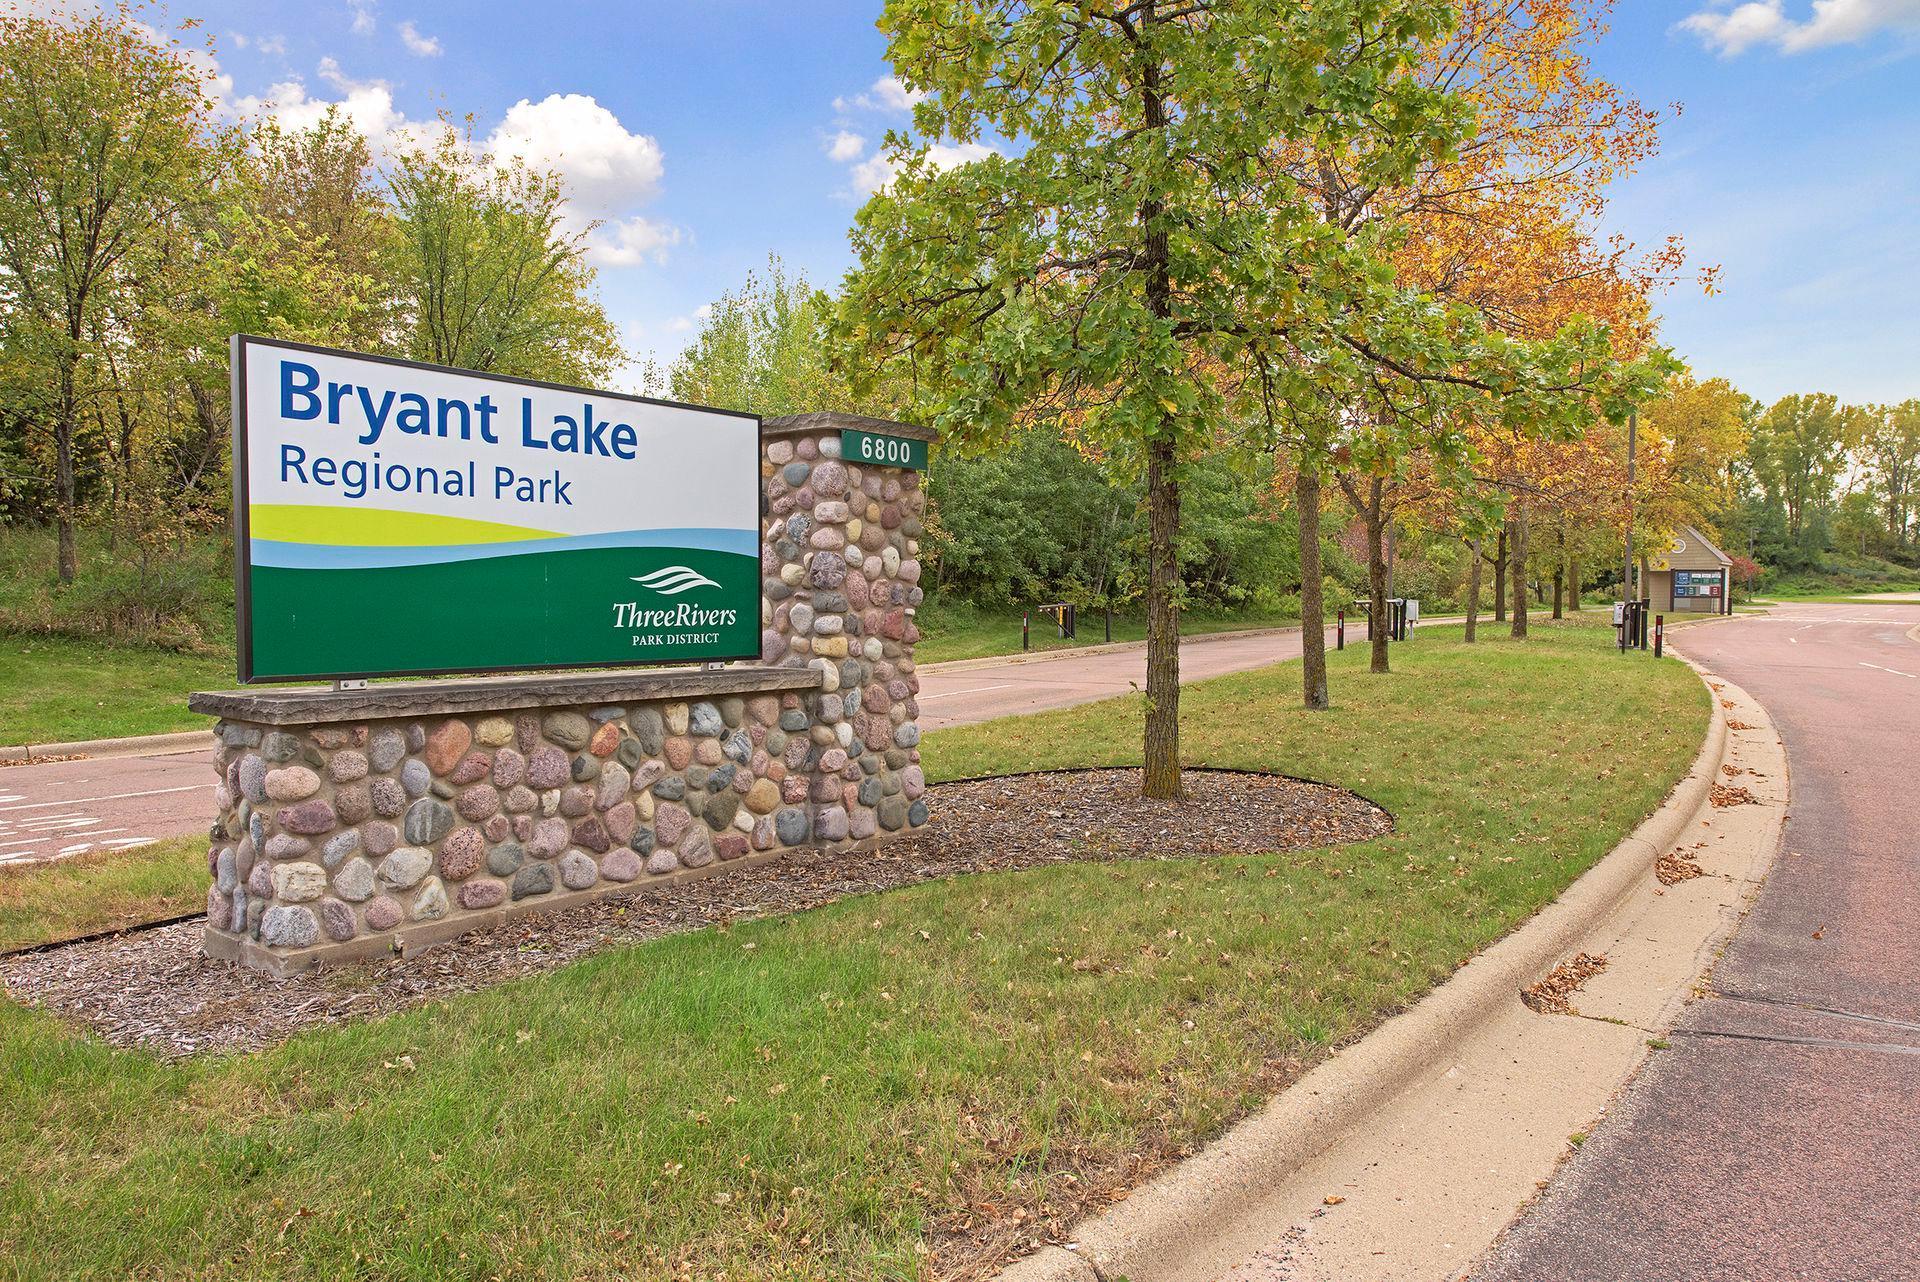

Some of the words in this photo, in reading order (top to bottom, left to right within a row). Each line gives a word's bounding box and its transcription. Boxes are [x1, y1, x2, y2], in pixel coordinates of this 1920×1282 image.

[281, 360, 499, 445] Bryant
[522, 397, 638, 459] Lake
[862, 437, 910, 463] 6800
[281, 444, 475, 498] Regional
[495, 467, 573, 505] Park
[613, 602, 736, 627] ThreeRivers
[632, 635, 664, 645] PARK
[667, 633, 720, 645] DISTRICT
